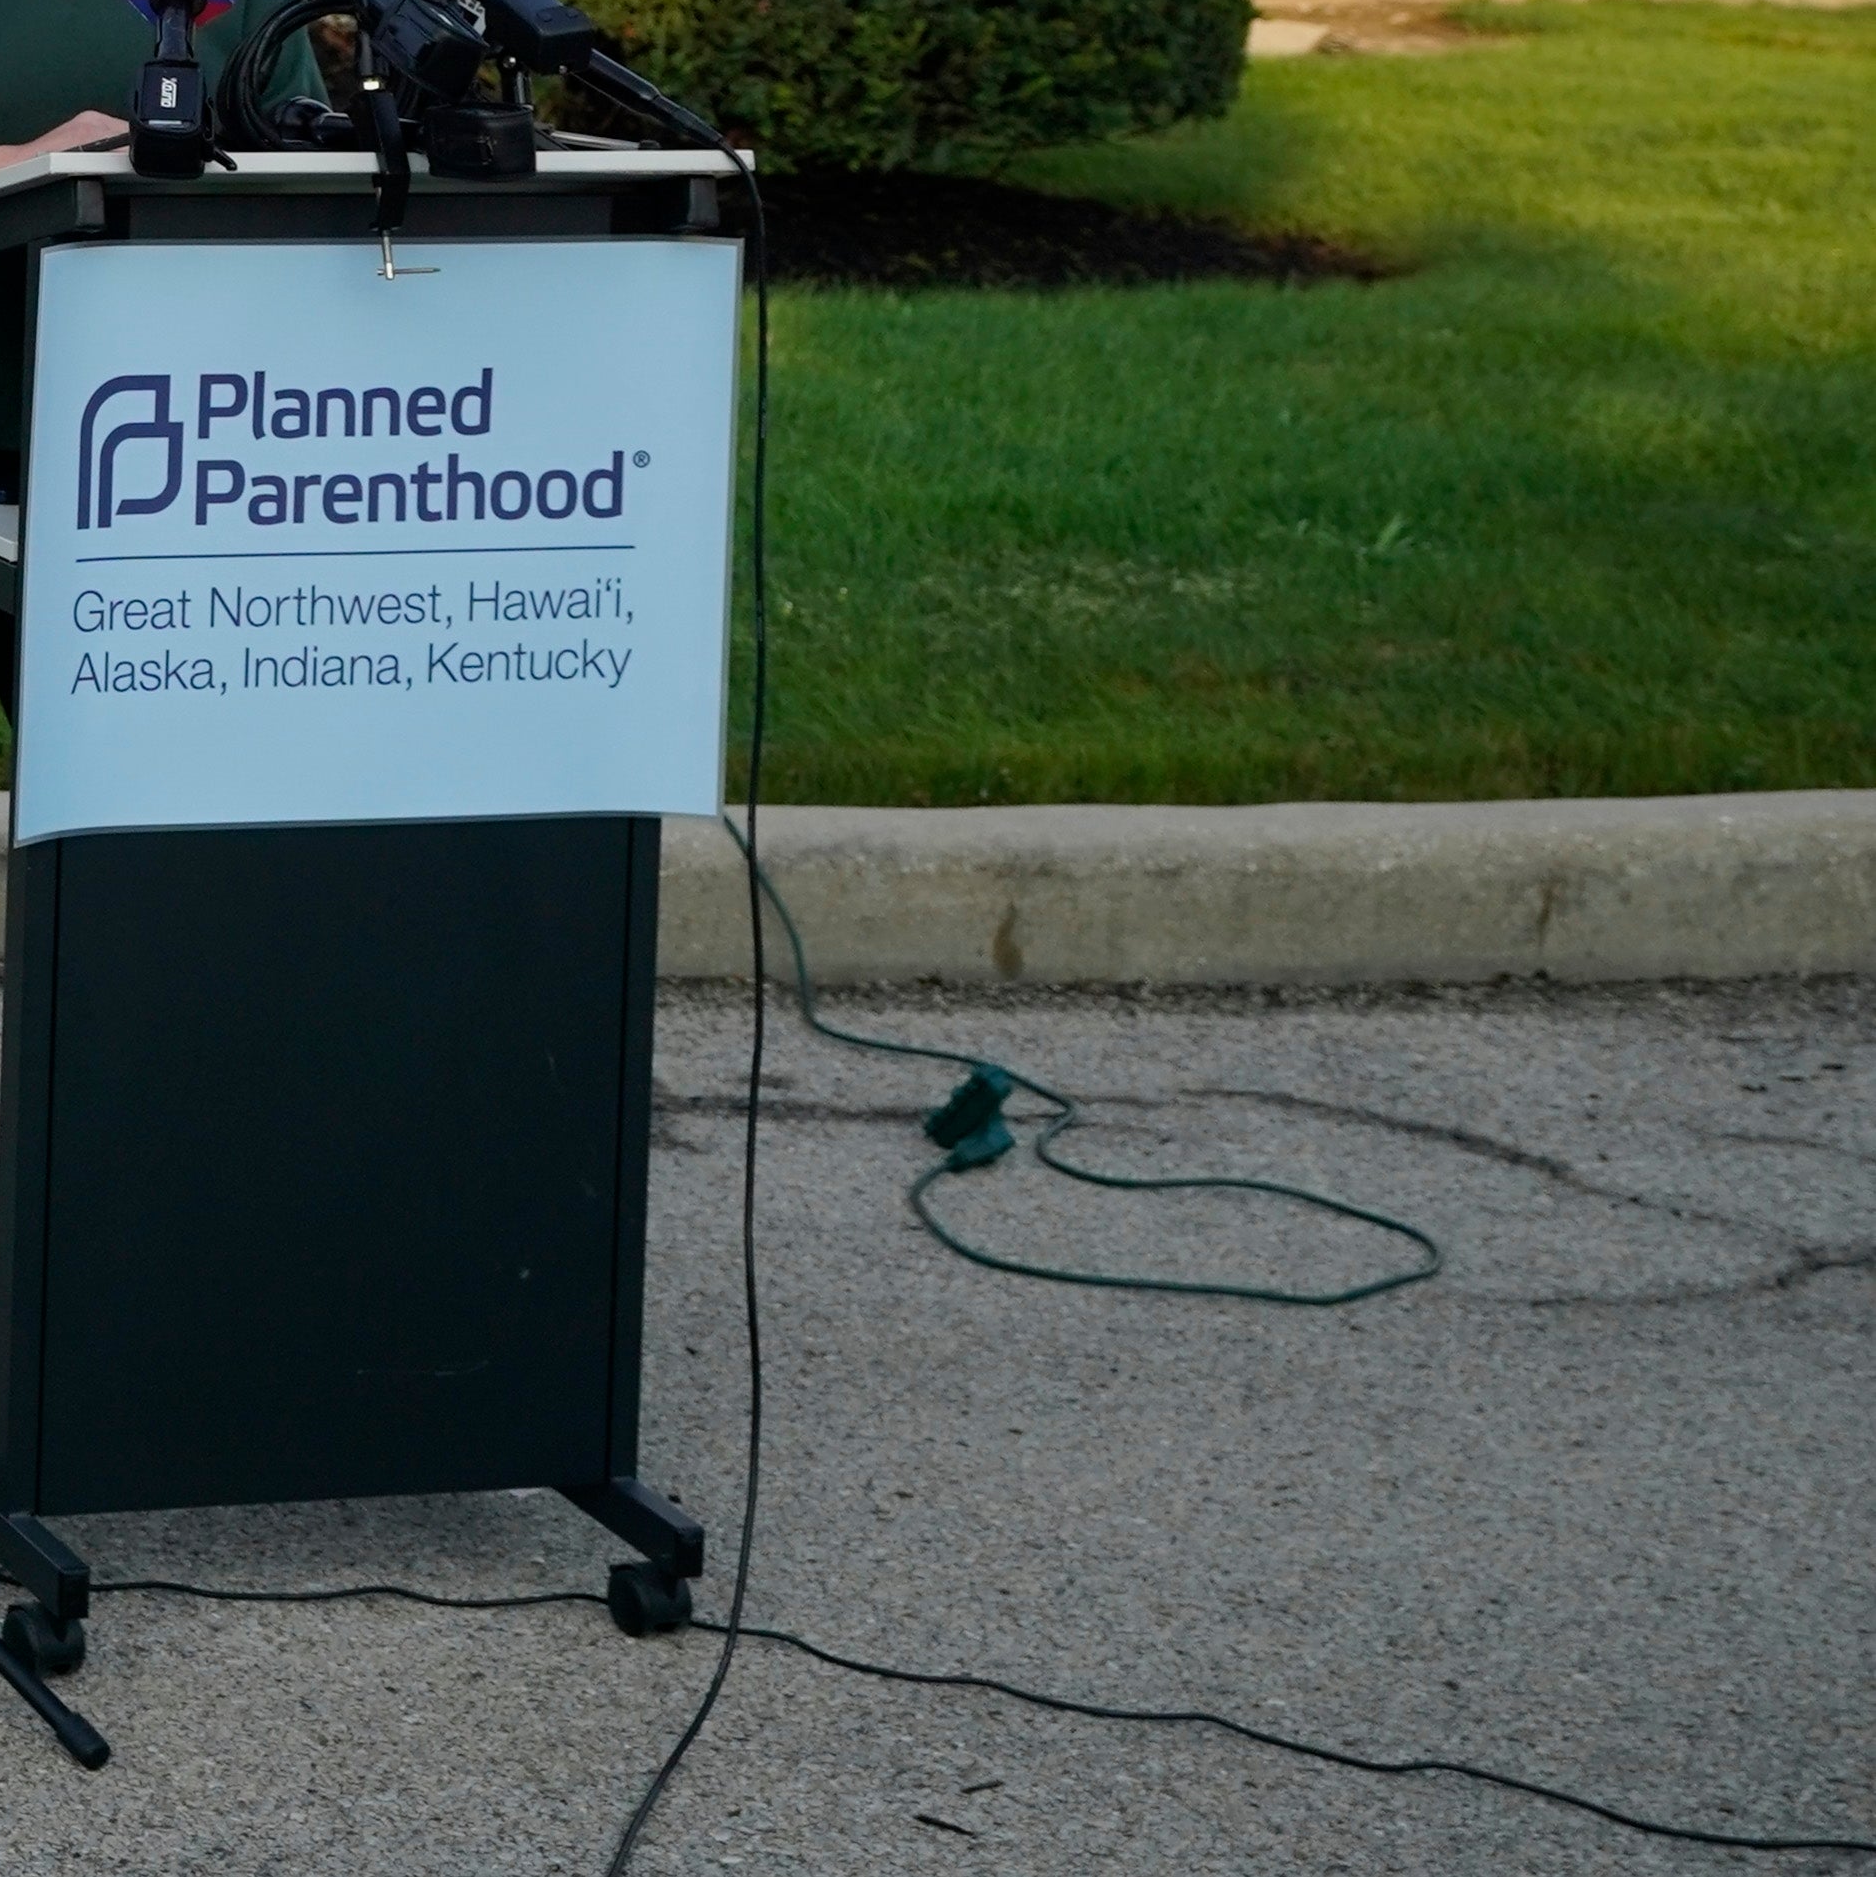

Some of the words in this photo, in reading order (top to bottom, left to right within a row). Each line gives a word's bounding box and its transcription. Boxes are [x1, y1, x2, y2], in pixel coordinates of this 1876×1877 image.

[196, 367, 494, 441] Planned
[72, 588, 192, 633] Great
[208, 584, 453, 629] Northwest,
[70, 648, 228, 697] Alaska,
[243, 645, 413, 692] Indiana,
[427, 638, 632, 689] Kentucky
